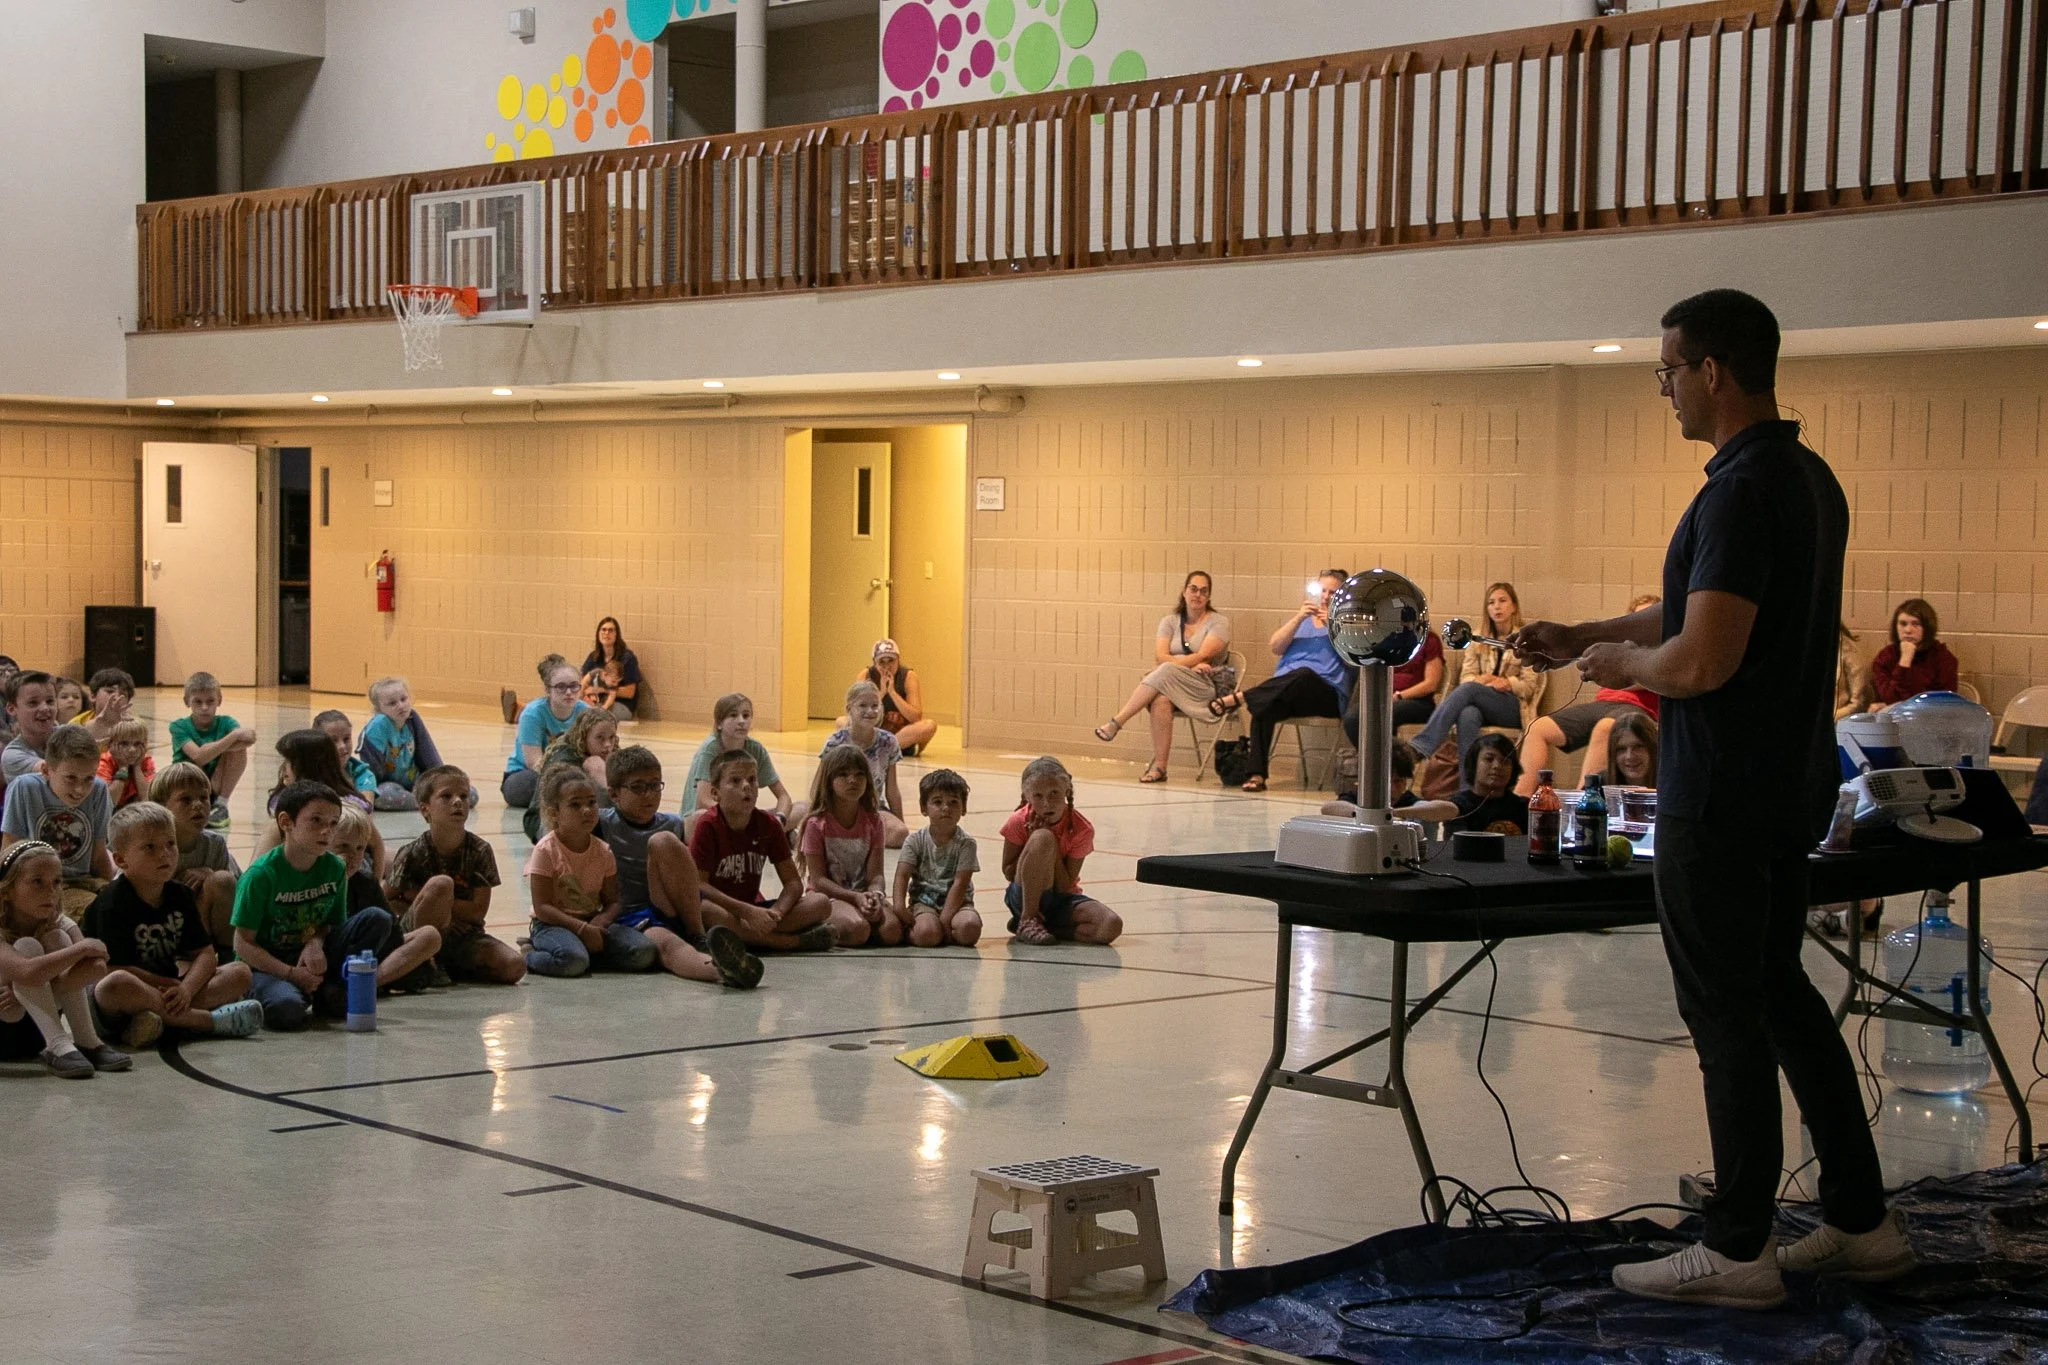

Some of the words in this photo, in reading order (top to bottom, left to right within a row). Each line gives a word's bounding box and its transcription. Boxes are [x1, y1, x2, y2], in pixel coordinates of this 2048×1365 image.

[979, 483, 1000, 494] Dining
[980, 495, 1000, 505] Room
[275, 882, 337, 903] MINECRAFT
